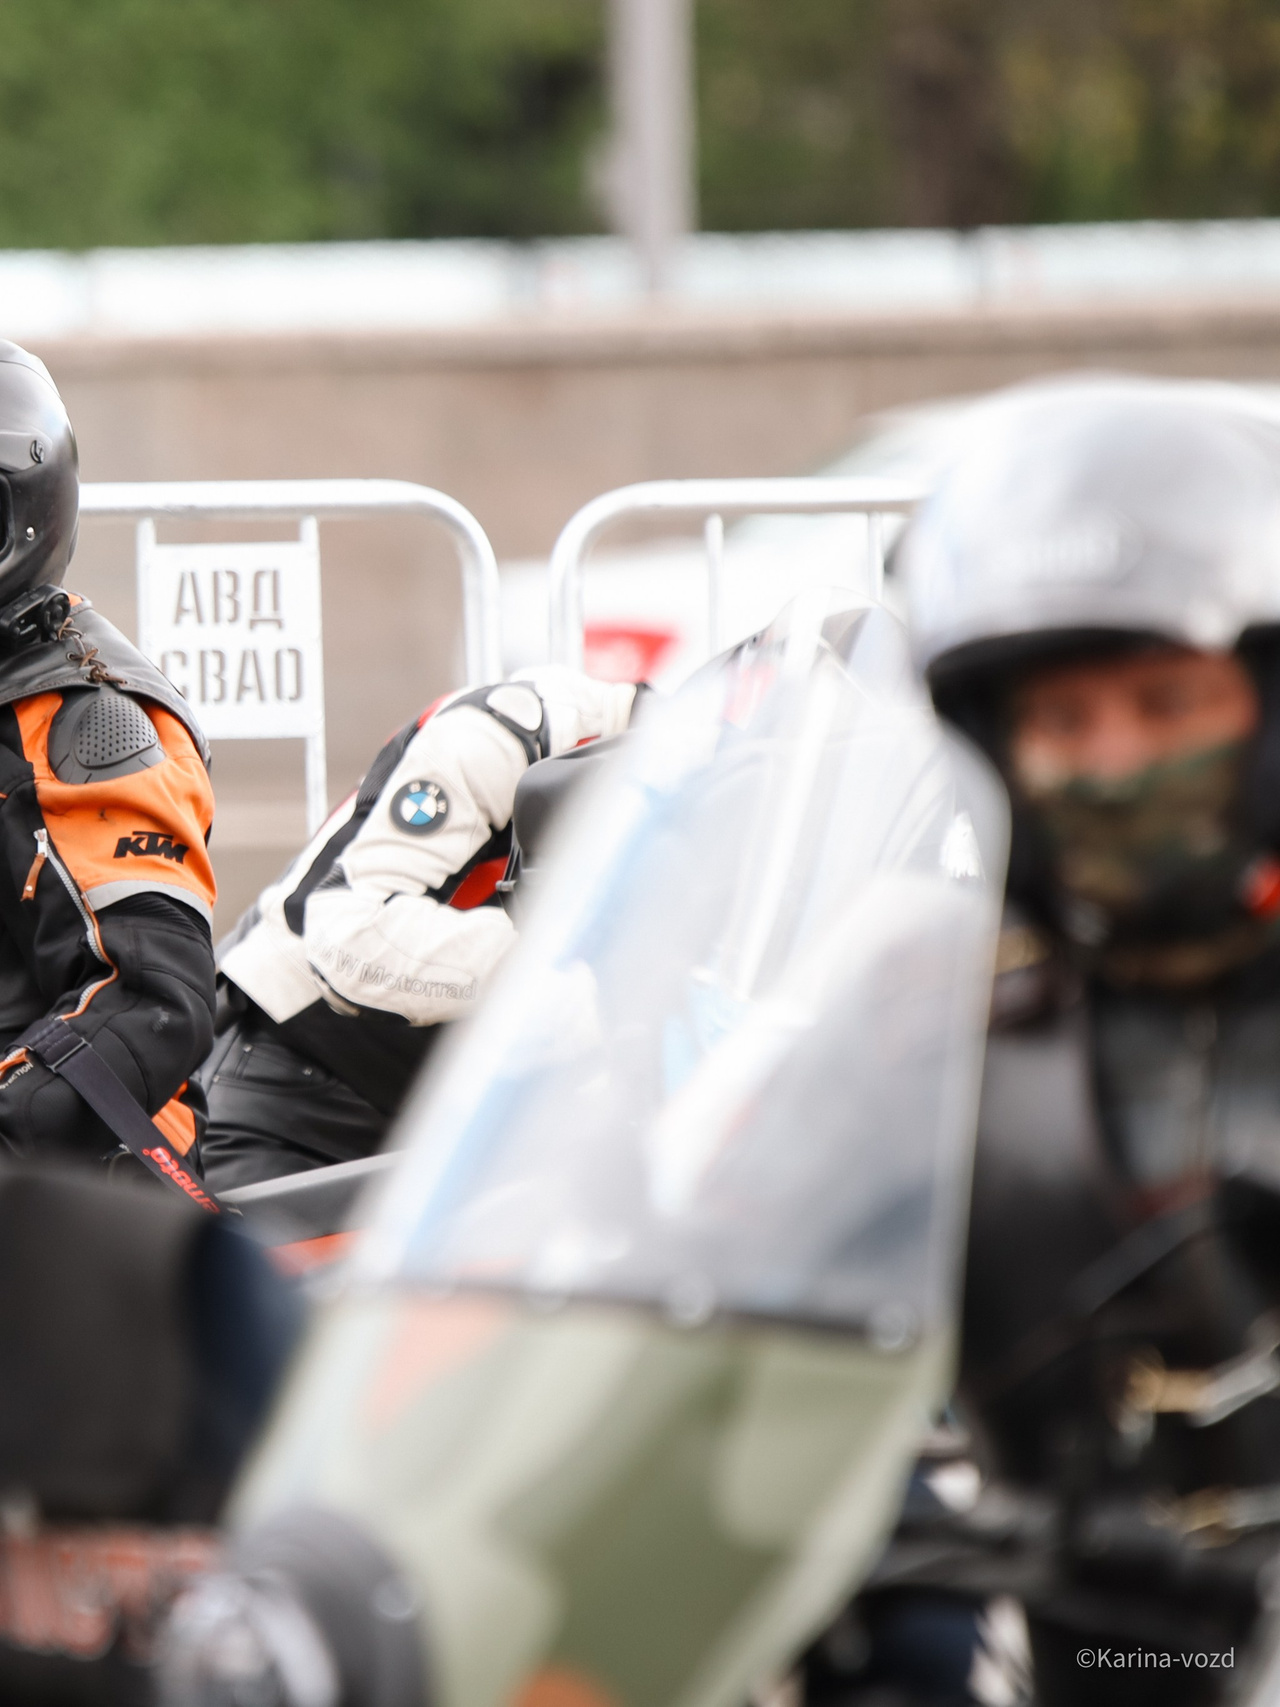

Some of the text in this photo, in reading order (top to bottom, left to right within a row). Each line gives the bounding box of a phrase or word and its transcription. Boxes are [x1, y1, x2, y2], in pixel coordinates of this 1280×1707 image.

[173, 570, 284, 630] АВД
[160, 649, 303, 704] СВАО
[409, 780, 447, 814] BMW
[113, 831, 190, 864] KTM
[358, 962, 479, 1001] Motorrad
